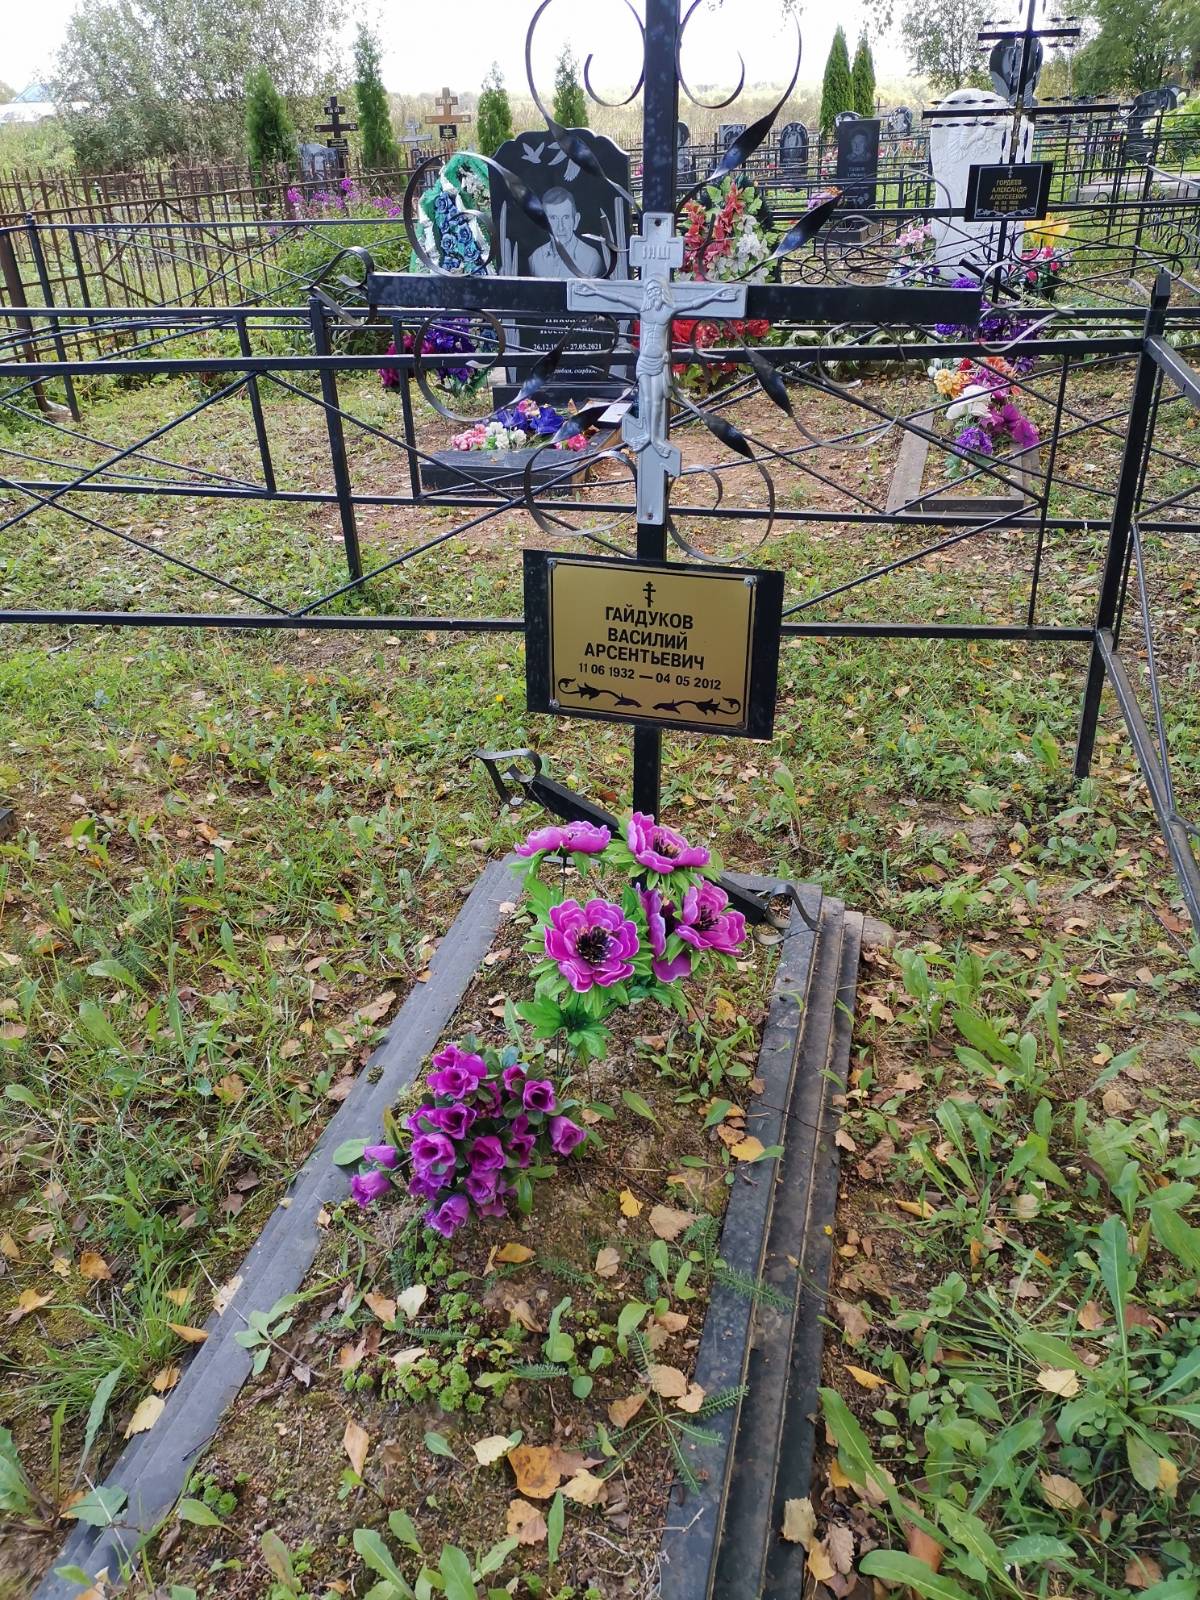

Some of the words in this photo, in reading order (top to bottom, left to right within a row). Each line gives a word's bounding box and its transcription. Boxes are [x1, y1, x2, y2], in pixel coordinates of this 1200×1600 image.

[604, 604, 694, 630] ГАЙДУКОВ
[607, 627, 688, 651] ВАСИЛИЙ
[584, 642, 705, 671] АРСЕНТЬЕВИЧ
[578, 663, 588, 674] 11
[590, 664, 605, 676] 06
[609, 666, 635, 680] 1932
[655, 672, 671, 685] 04
[675, 675, 690, 687] 05
[693, 677, 722, 691] 2012
